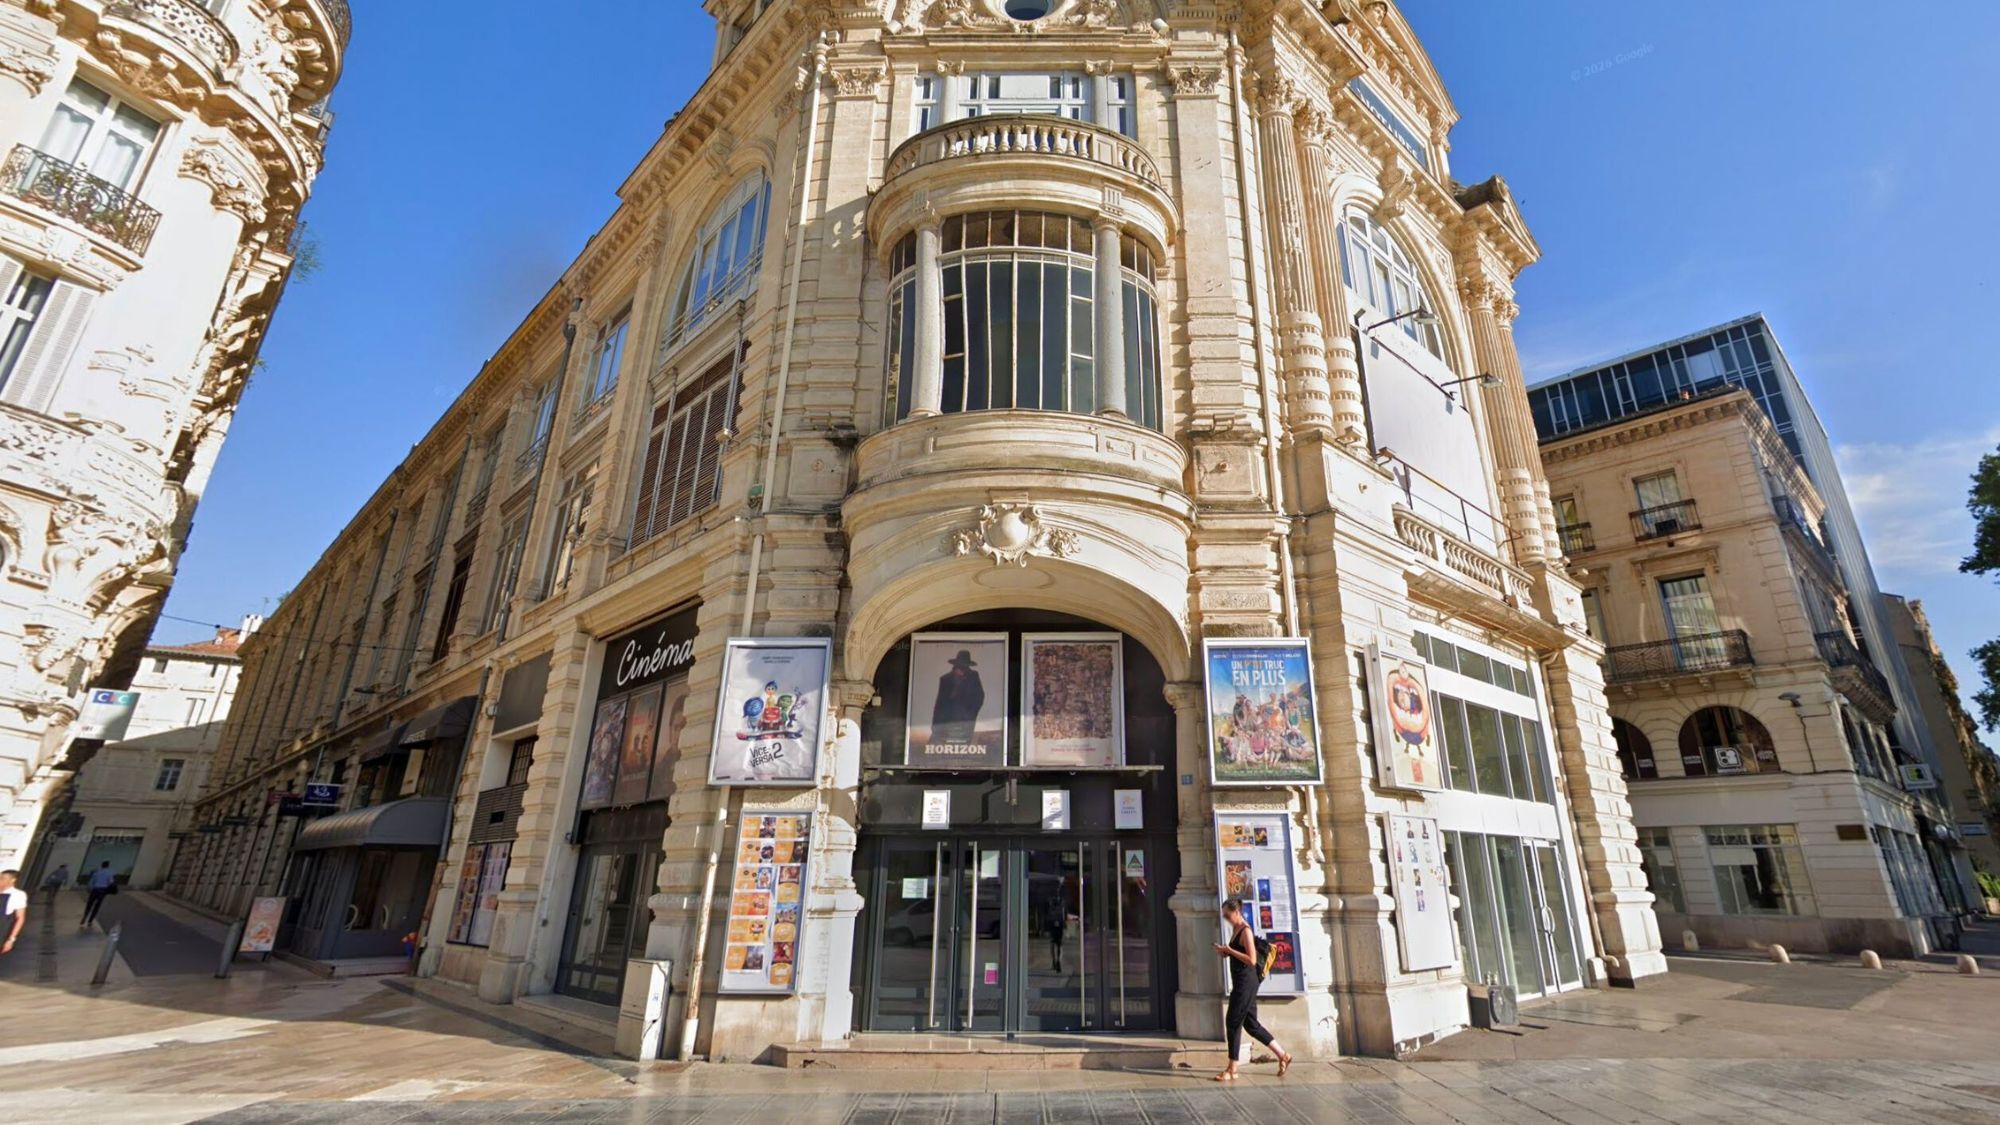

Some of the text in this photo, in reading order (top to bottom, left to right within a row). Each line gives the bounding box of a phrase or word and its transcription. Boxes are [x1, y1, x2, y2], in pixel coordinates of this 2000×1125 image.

[617, 631, 693, 687] Cinéma
[1231, 661, 1243, 670] UN
[1264, 660, 1285, 670] TRUC
[1232, 670, 1286, 686] EN PLUS
[772, 742, 784, 759] 2
[924, 744, 987, 755] HORIZON
[750, 754, 774, 768] VERSA
